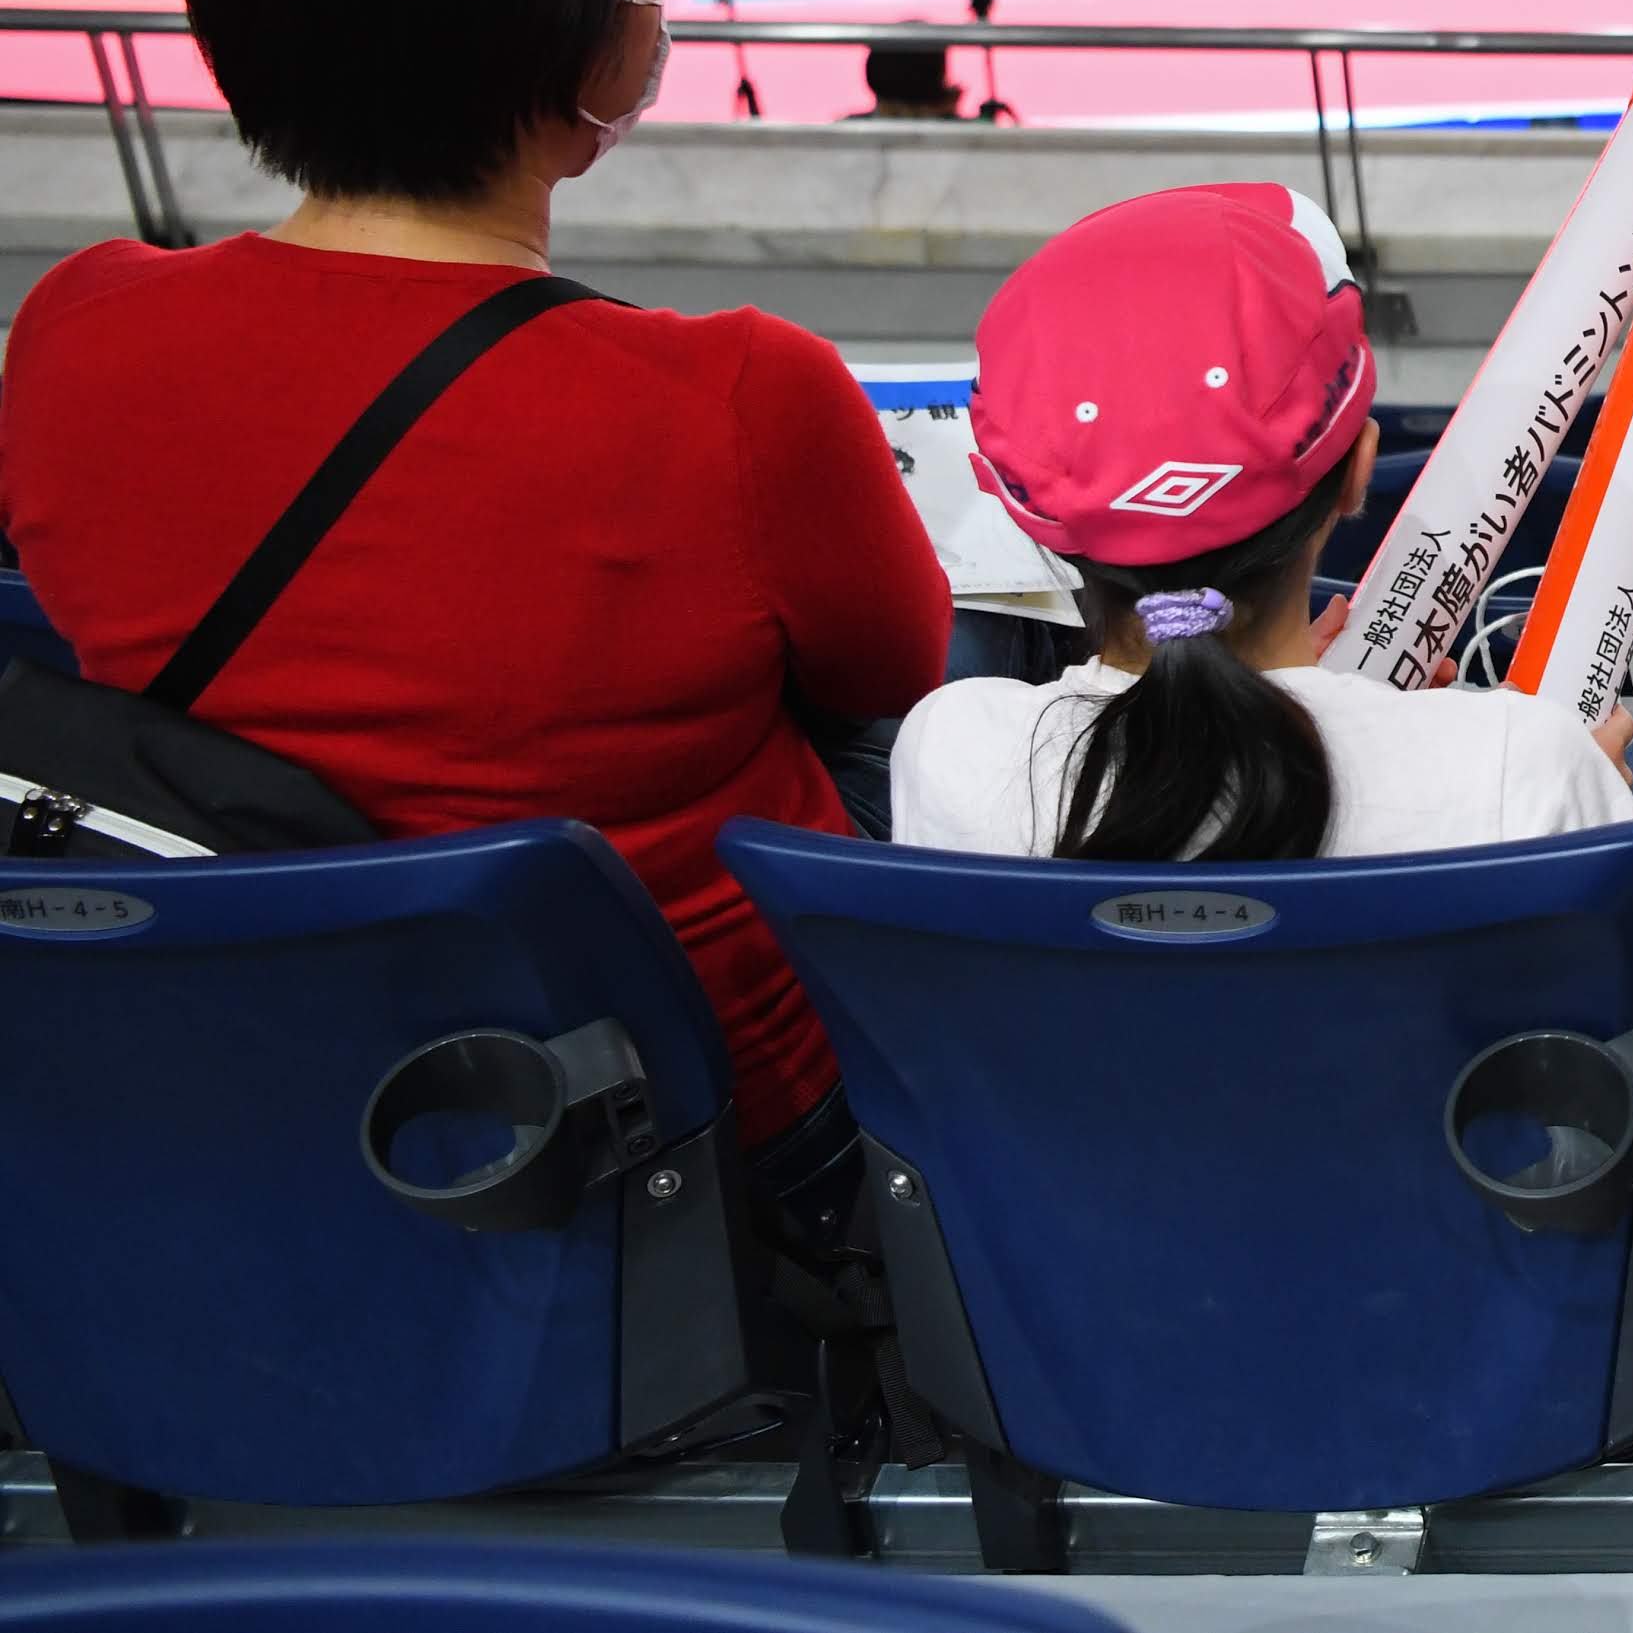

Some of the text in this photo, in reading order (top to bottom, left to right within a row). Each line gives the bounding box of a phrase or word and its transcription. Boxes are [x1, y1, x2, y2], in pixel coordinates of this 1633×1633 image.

[1357, 529, 1452, 671] 一般社団法人
